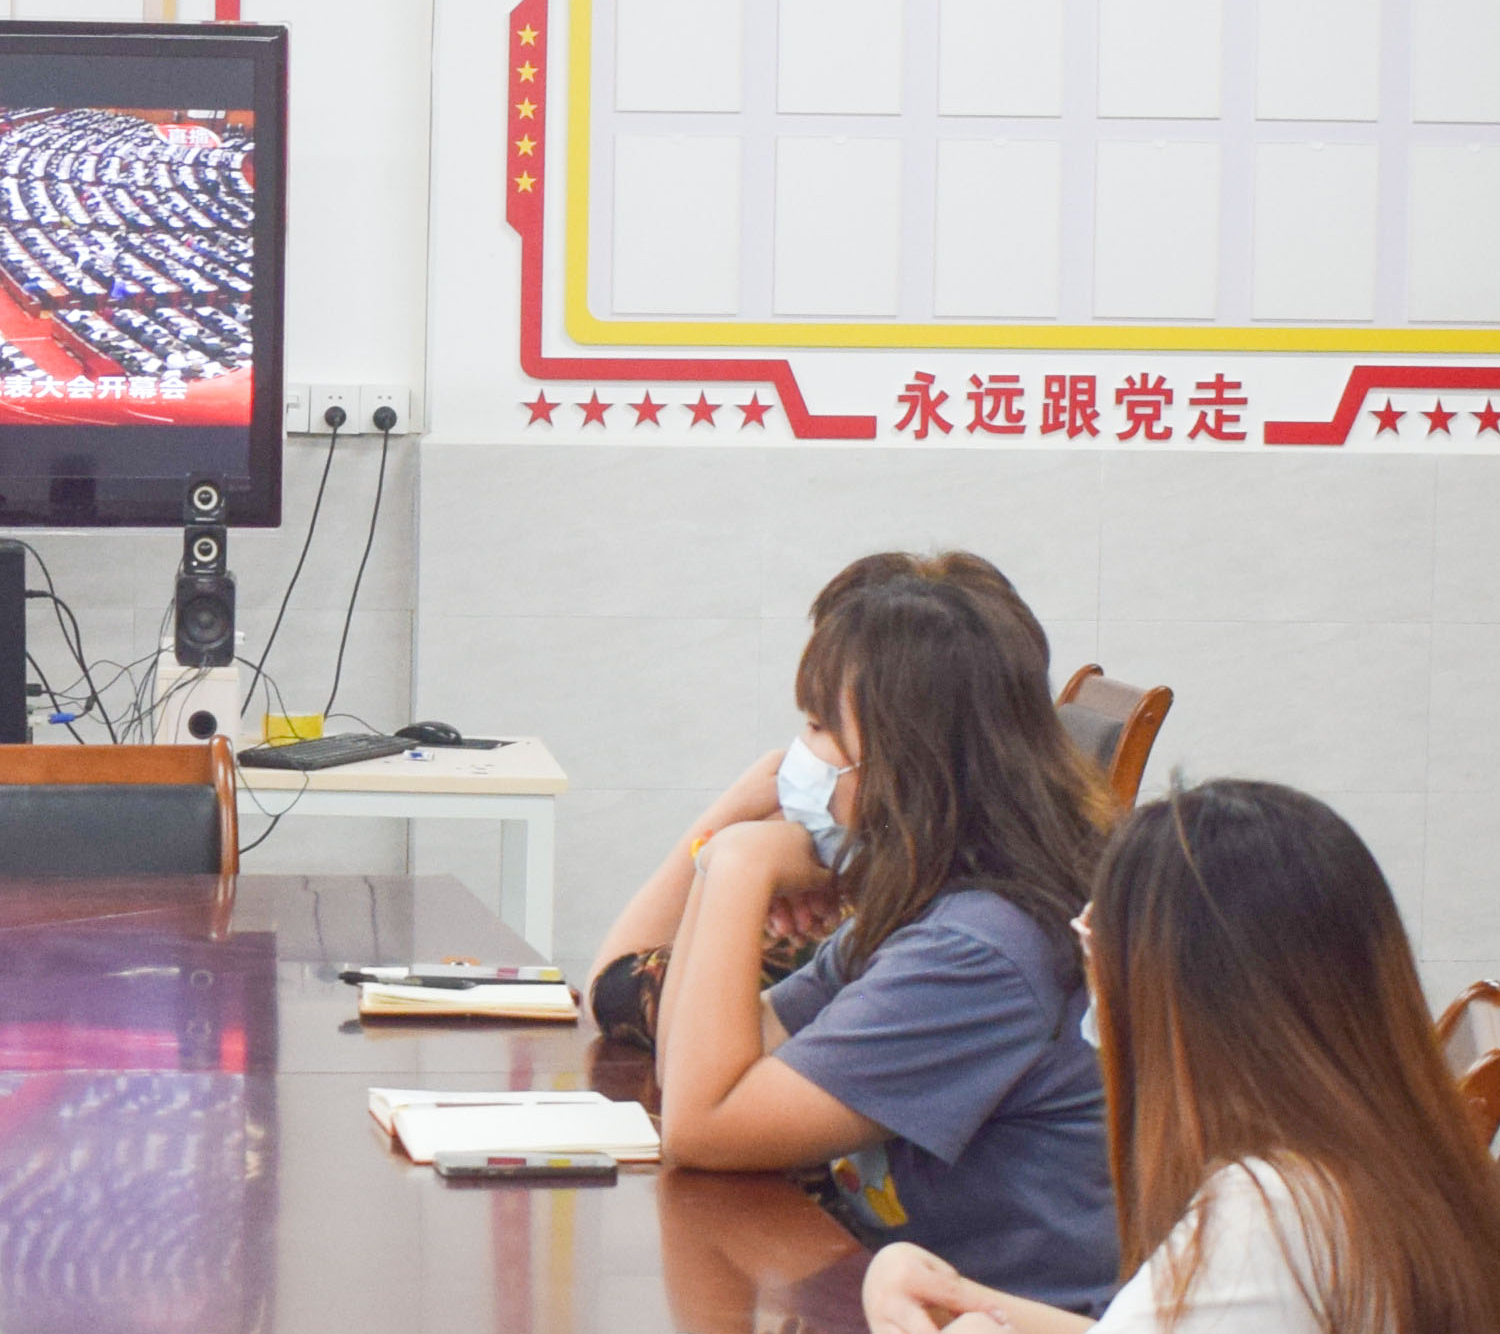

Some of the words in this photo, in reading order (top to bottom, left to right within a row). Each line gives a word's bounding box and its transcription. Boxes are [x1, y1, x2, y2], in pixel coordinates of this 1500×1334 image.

[896, 373, 1248, 440] 永远跟党走
